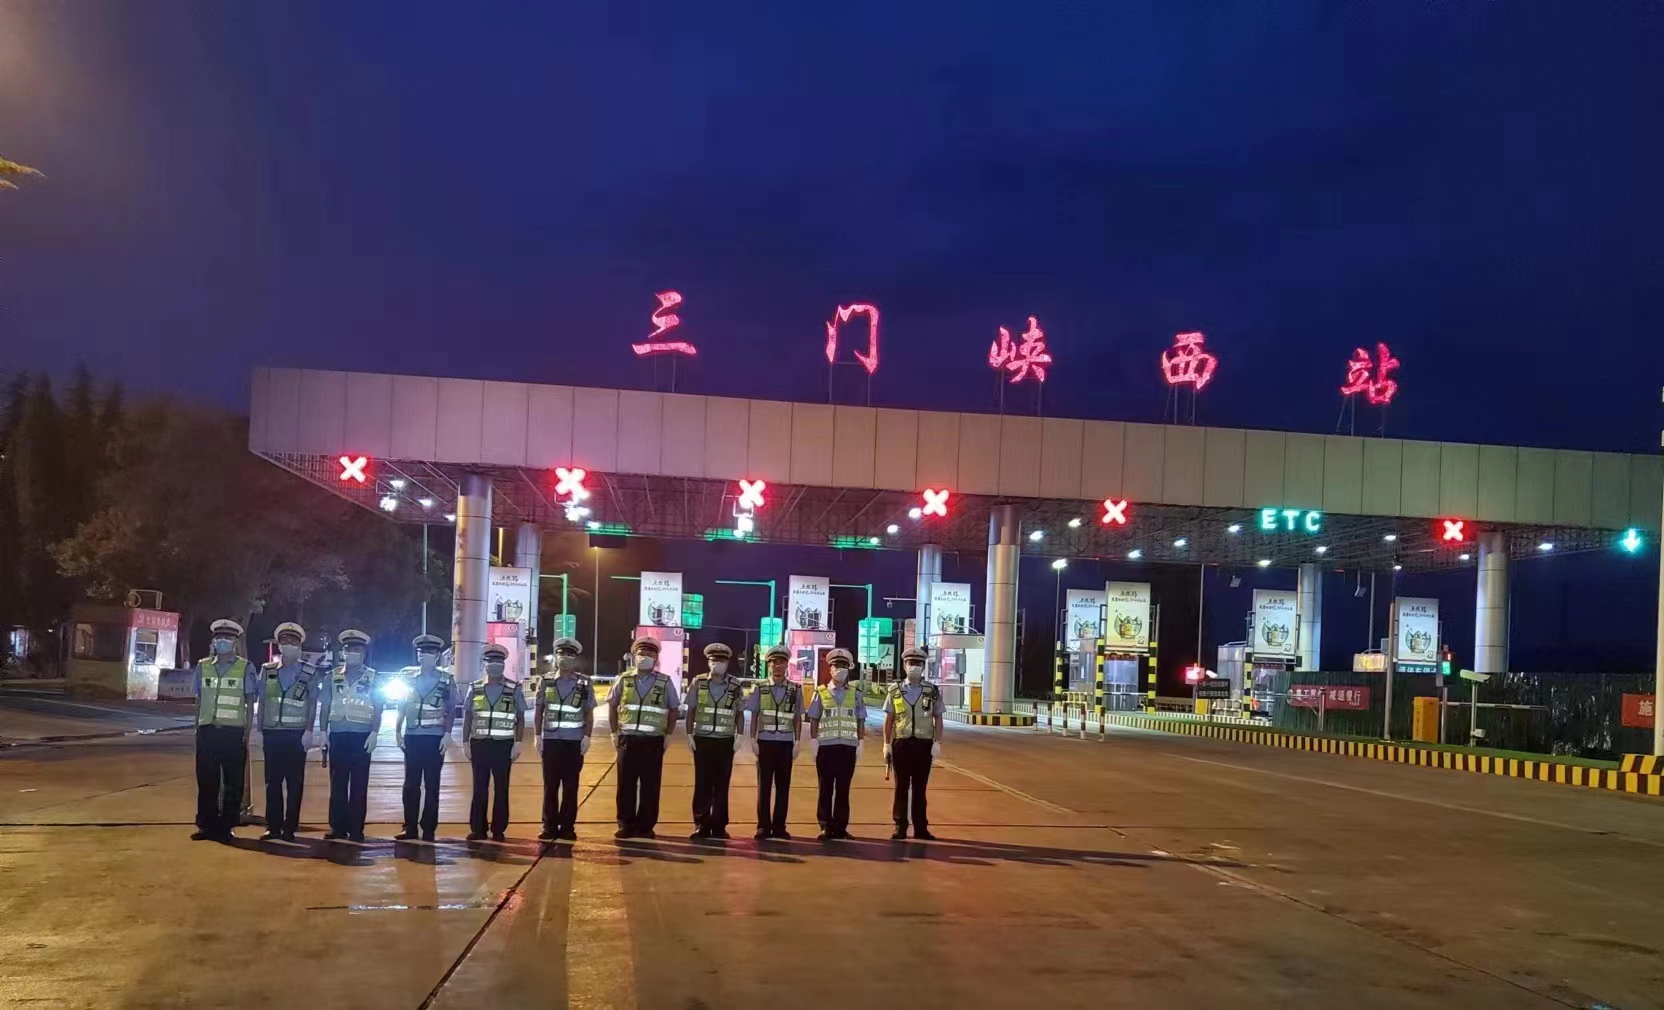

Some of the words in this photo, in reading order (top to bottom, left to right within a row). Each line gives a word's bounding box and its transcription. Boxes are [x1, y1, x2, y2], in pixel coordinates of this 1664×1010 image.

[632, 290, 1400, 405] 三门峡西站
[1261, 508, 1321, 531] ETC
[1637, 699, 1654, 716] 施
